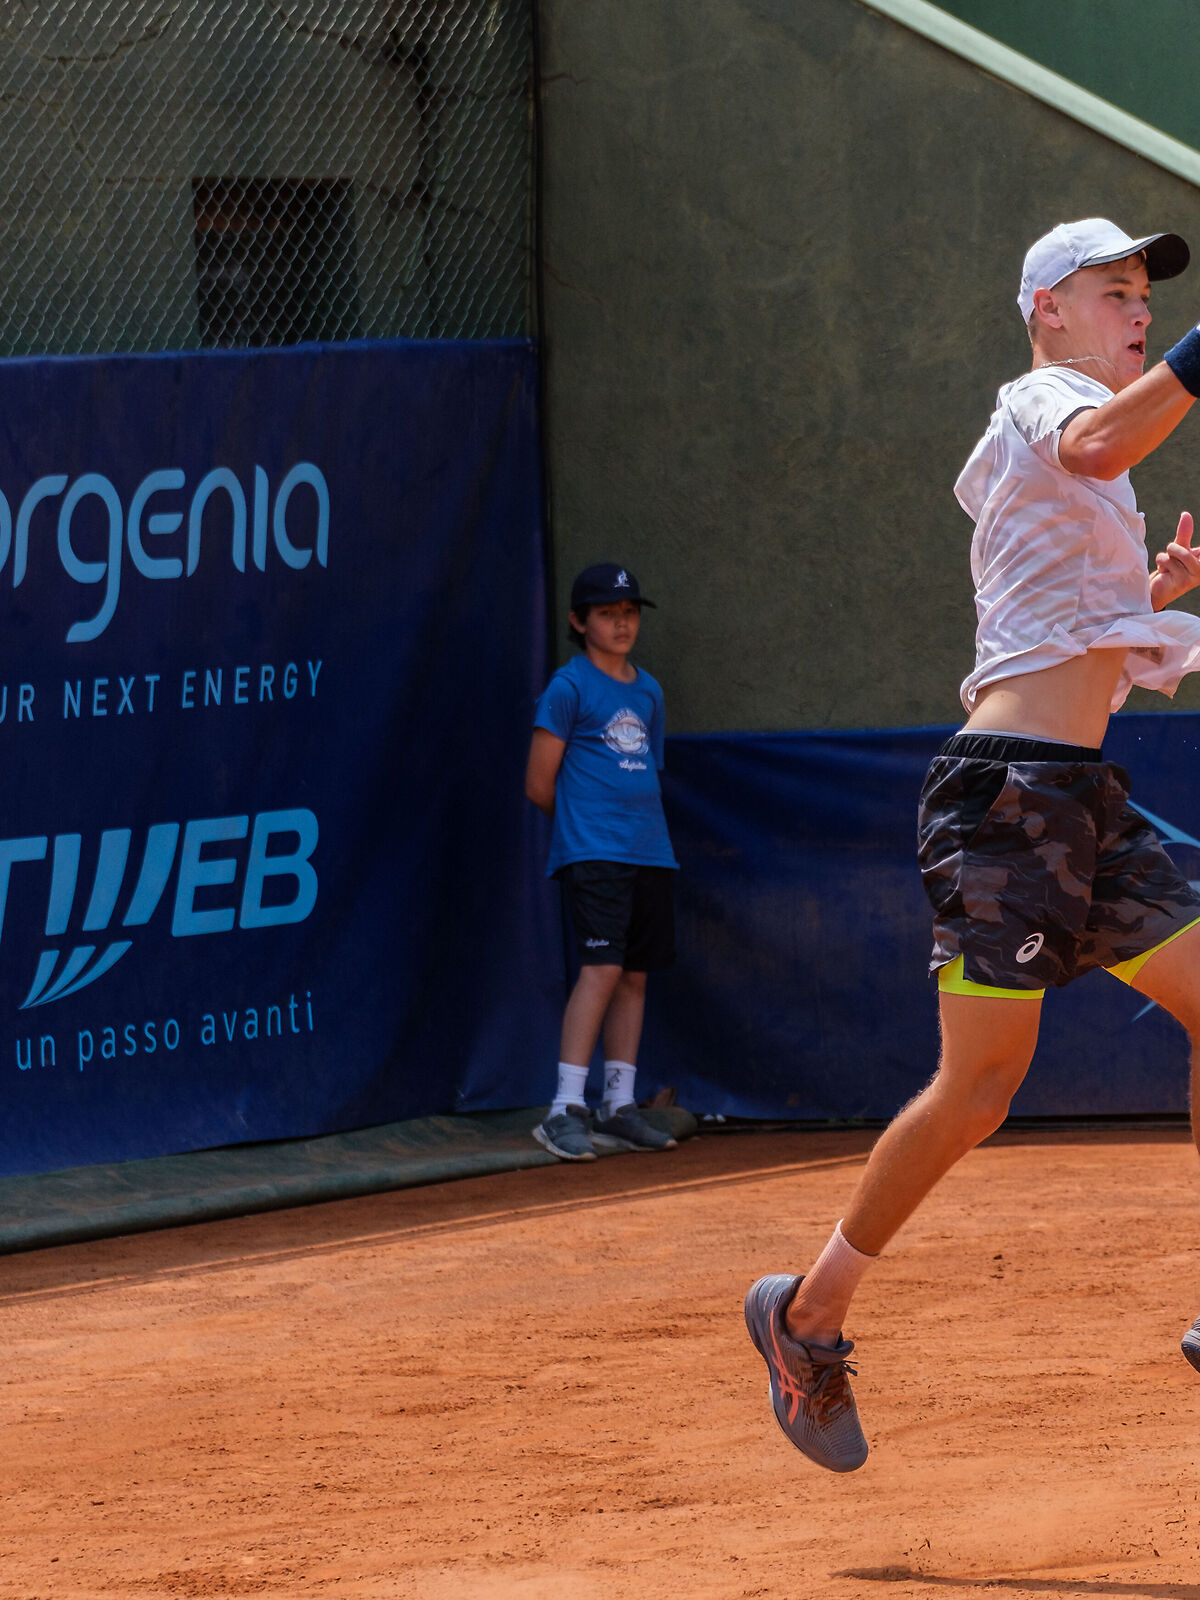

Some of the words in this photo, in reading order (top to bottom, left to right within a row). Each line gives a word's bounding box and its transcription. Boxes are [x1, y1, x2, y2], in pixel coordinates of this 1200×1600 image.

[63, 674, 161, 719] NEXT
[181, 660, 323, 709] ENERGY
[16, 1034, 56, 1071] un
[78, 1018, 180, 1072] passo
[201, 991, 314, 1046] avanti
